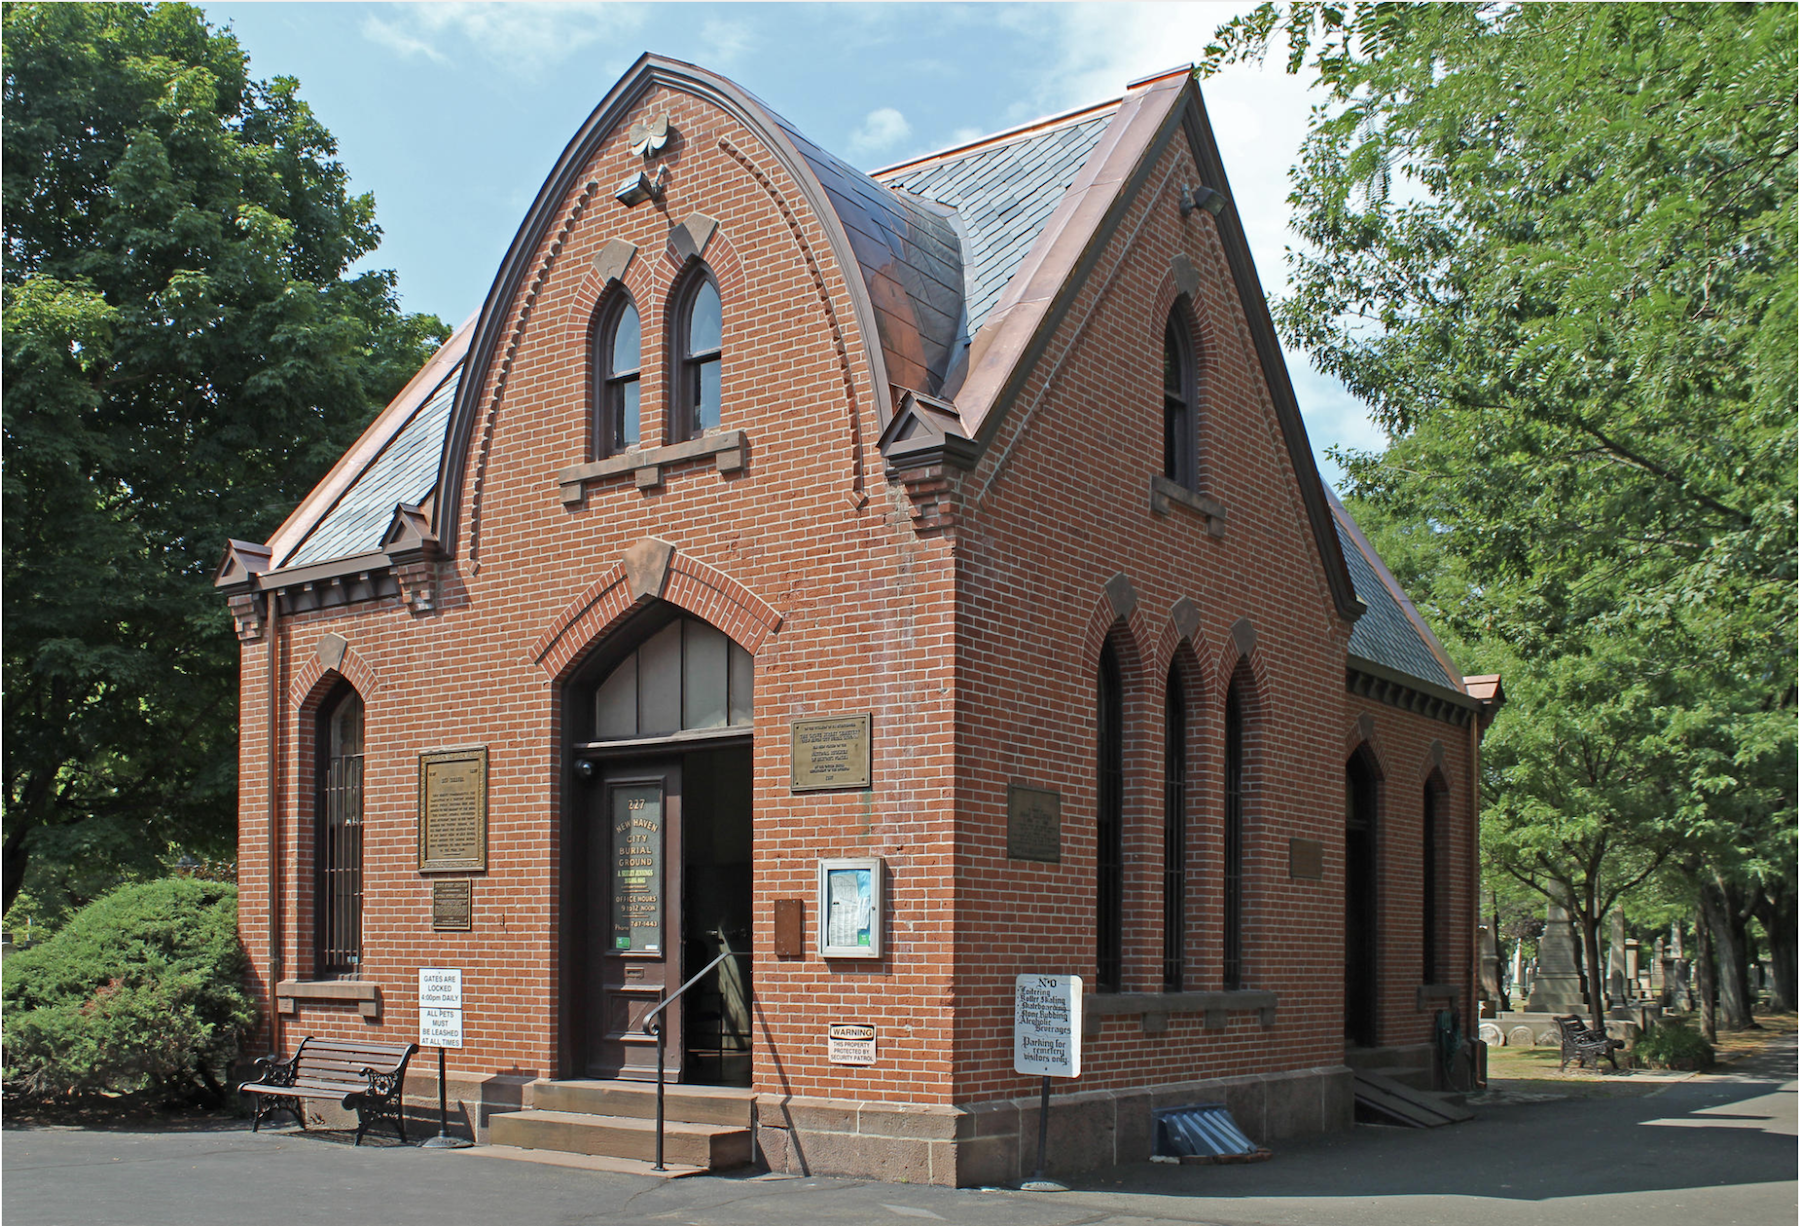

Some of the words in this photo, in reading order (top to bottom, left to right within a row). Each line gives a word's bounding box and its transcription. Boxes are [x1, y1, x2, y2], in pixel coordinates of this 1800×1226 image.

[628, 799, 645, 810] 227
[616, 820, 631, 833] NEW
[633, 819, 658, 833] HAVEN
[626, 834, 648, 843] CITY
[619, 846, 652, 855] BURIAL
[618, 858, 653, 867] GROUND
[638, 895, 657, 903] HOURS
[424, 975, 443, 983] GATES
[428, 984, 452, 992] LOCKED
[421, 994, 441, 1002] 4:00pm
[1040, 995, 1066, 1005] Skating
[439, 1010, 454, 1018] PETS
[432, 1019, 448, 1027] MUST
[431, 1028, 459, 1037] LEASHED
[833, 1028, 873, 1037] WARNING
[1035, 1024, 1071, 1035] Beverages
[442, 1038, 460, 1047] TIMES
[1021, 1036, 1054, 1049] Parking
[1055, 1038, 1066, 1048] for
[1023, 1053, 1050, 1063] visitors
